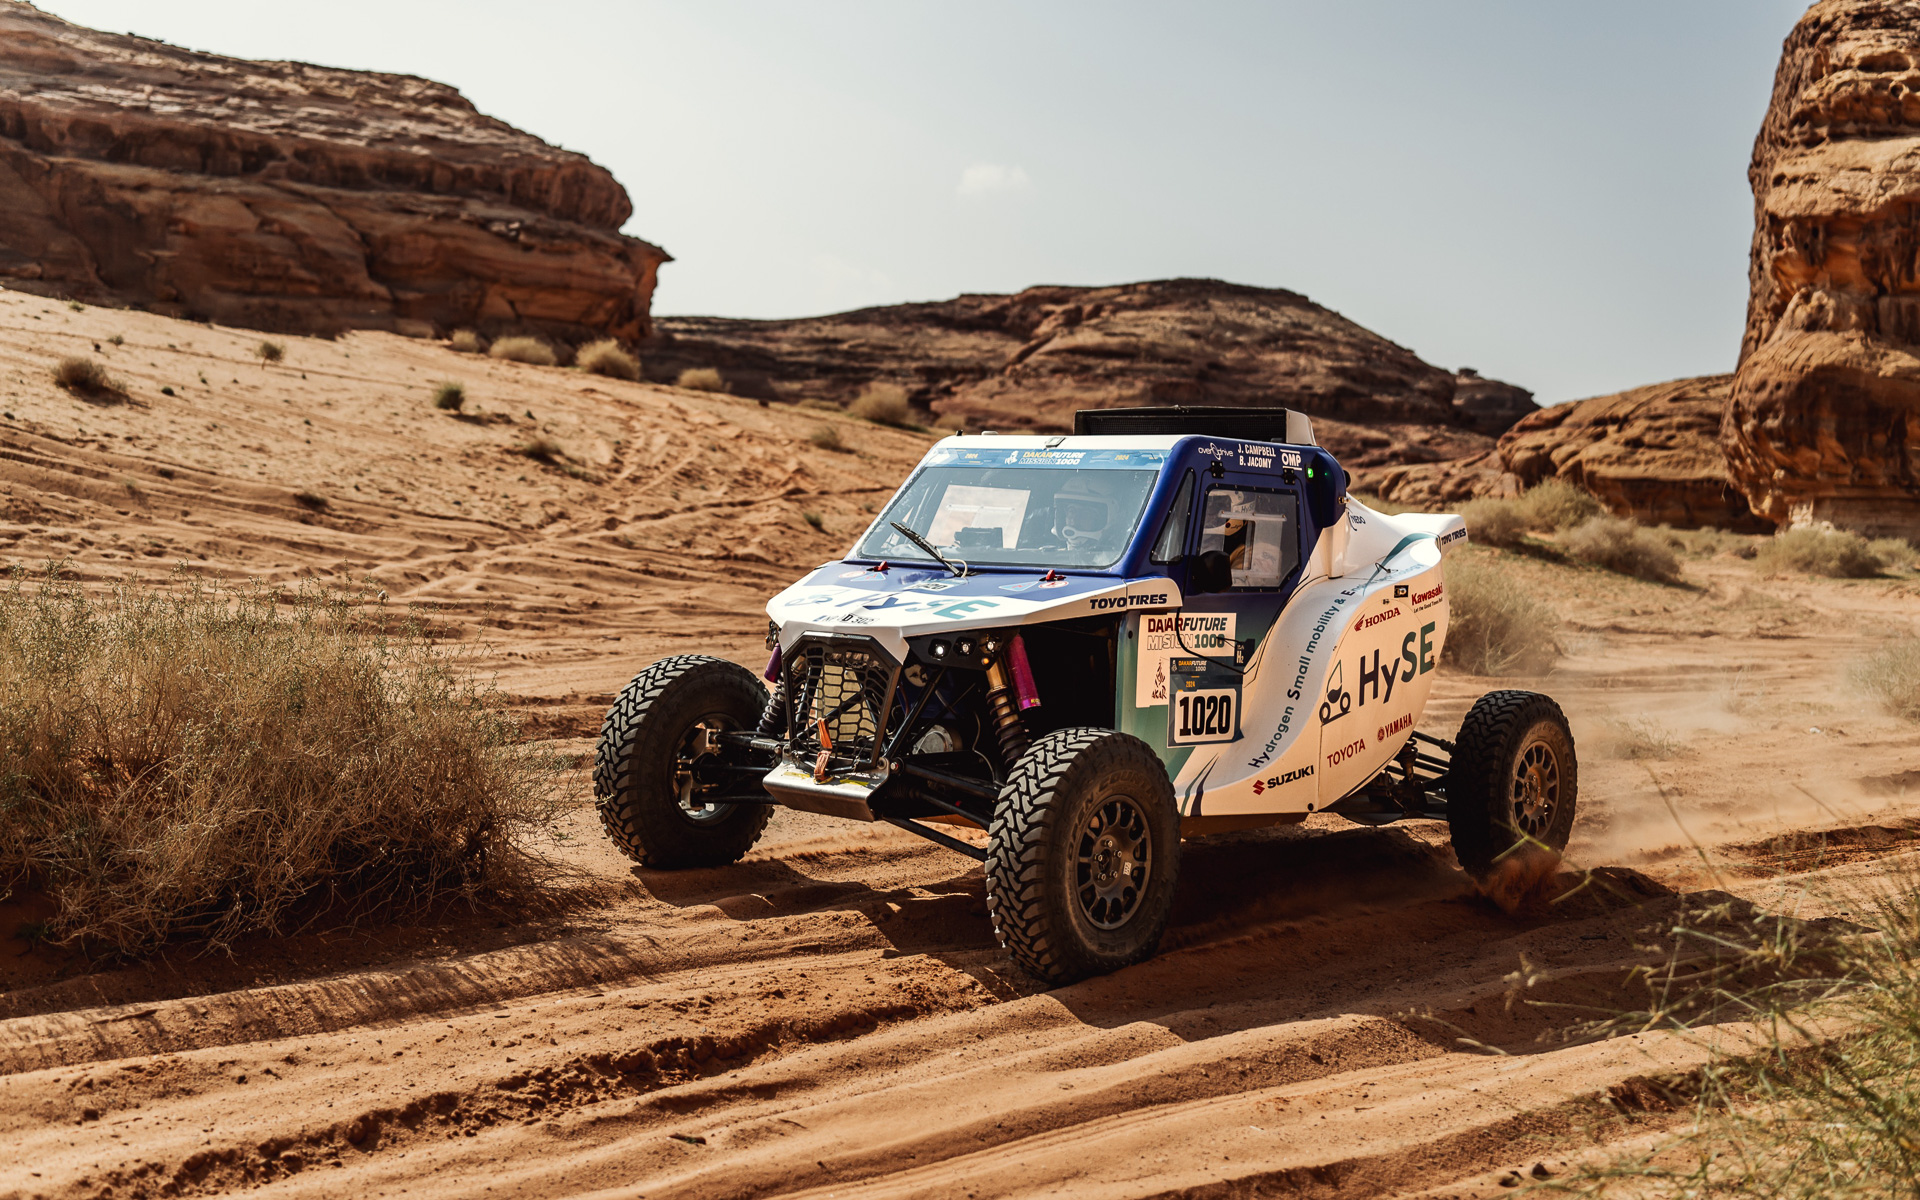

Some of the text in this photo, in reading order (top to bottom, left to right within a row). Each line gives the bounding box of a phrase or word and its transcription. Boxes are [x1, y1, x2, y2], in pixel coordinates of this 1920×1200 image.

[1238, 443, 1277, 457] J. CAMPBELL
[1239, 455, 1272, 468] B. JACOMY
[1281, 453, 1302, 467] OMP
[1452, 527, 1467, 540] TIRES
[1089, 593, 1168, 609] TOYO TIRES
[1411, 582, 1443, 606] Kawasaki
[1364, 607, 1401, 628] HONDA
[1358, 621, 1436, 707] HySE
[1248, 706, 1295, 769] Hydrogen
[1287, 655, 1312, 701] Small
[1305, 605, 1340, 654] mobility
[1334, 598, 1347, 606] &
[1179, 695, 1231, 737] 1020
[1384, 713, 1413, 738] YAMAHA
[1326, 738, 1366, 768] TOYOTA
[1267, 765, 1315, 789] SUZUKI
